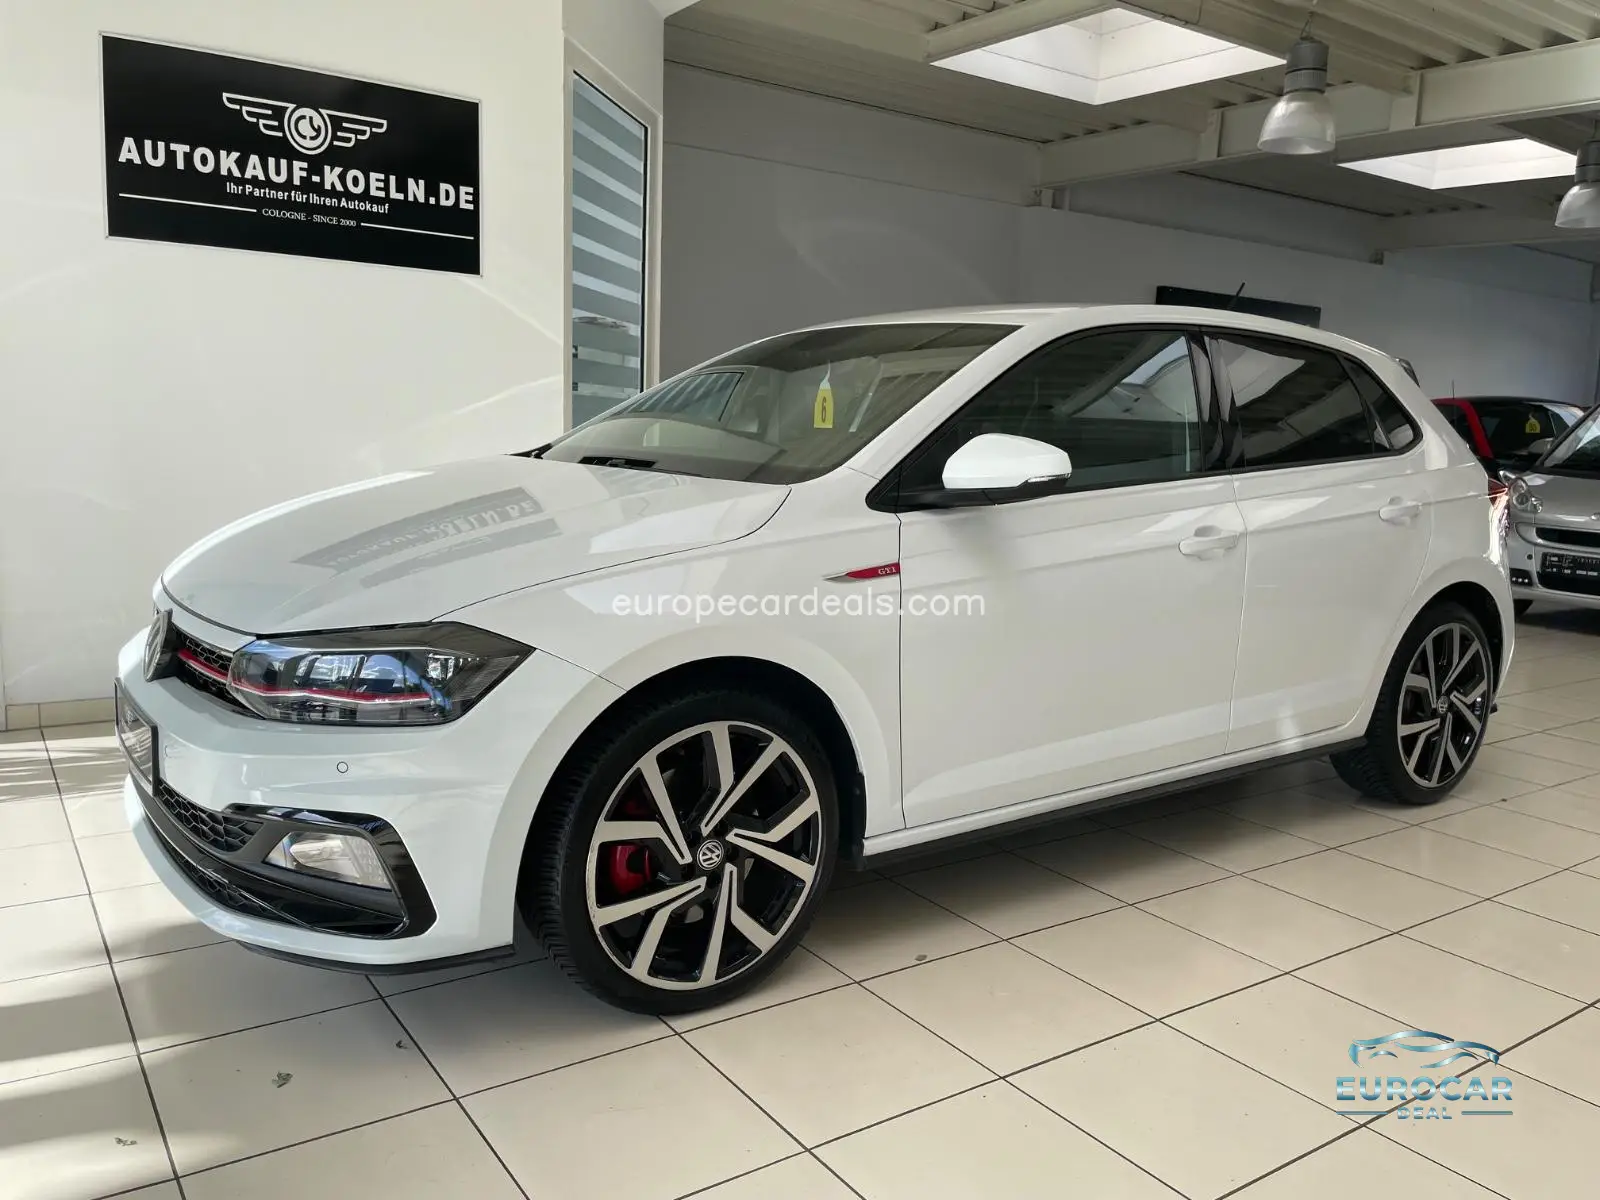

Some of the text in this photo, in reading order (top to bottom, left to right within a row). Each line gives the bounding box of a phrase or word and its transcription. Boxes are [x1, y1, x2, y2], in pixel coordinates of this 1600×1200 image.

[118, 137, 475, 210] AUTOKAUF-KOELN.DE
[226, 181, 390, 214] Ihr Partner für Ihren Autokauf
[262, 208, 307, 221] COLOGNE
[313, 214, 338, 225] SINCE
[339, 218, 357, 227] 2000
[878, 566, 897, 575] GTI
